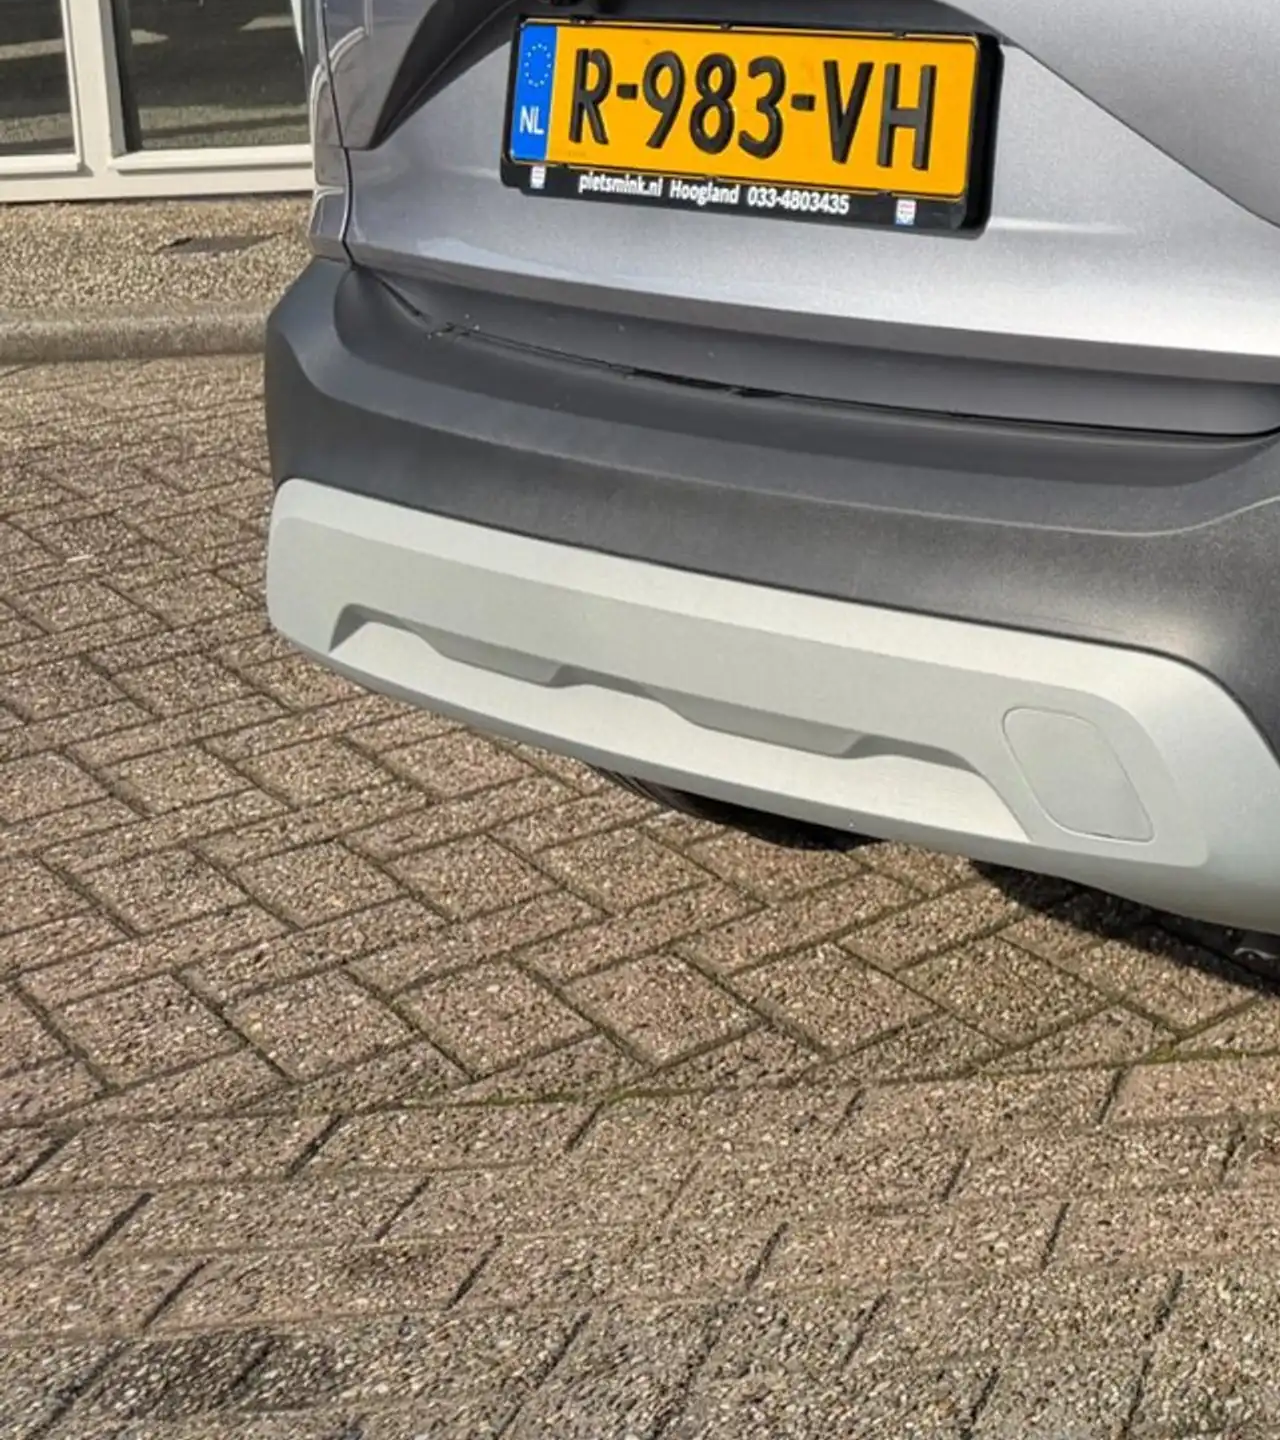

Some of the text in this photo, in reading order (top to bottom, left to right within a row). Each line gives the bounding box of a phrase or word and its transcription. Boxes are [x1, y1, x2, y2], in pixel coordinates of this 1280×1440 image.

[519, 106, 545, 136] NL
[568, 47, 938, 171] R-983-VH
[578, 172, 850, 216] pietsmink.nl Hoogland 033-4803435
